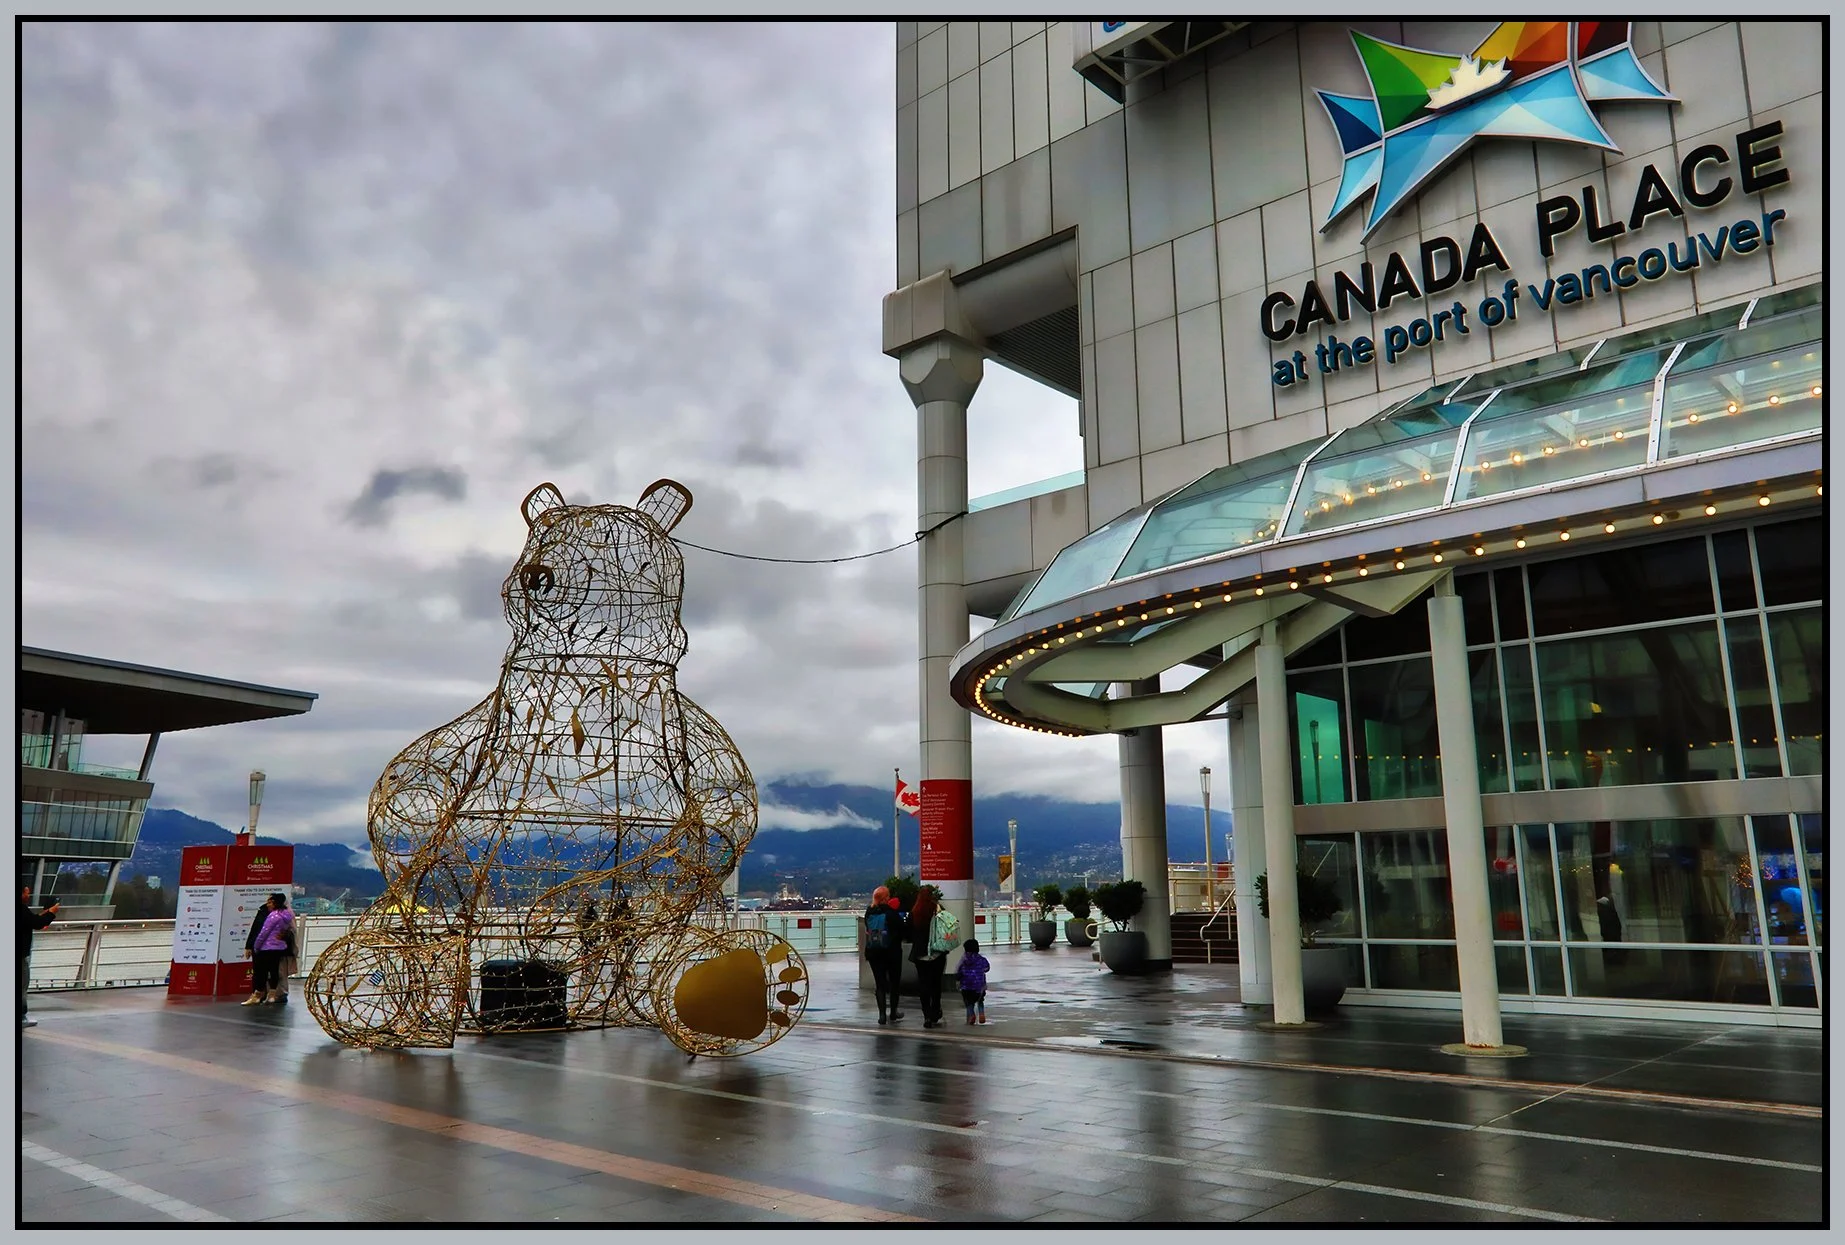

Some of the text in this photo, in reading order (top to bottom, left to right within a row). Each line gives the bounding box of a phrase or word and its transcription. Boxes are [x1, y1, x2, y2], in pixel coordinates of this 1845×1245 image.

[1260, 120, 1790, 341] CANADA PLACE
[1273, 208, 1786, 387] at the port of vancouver
